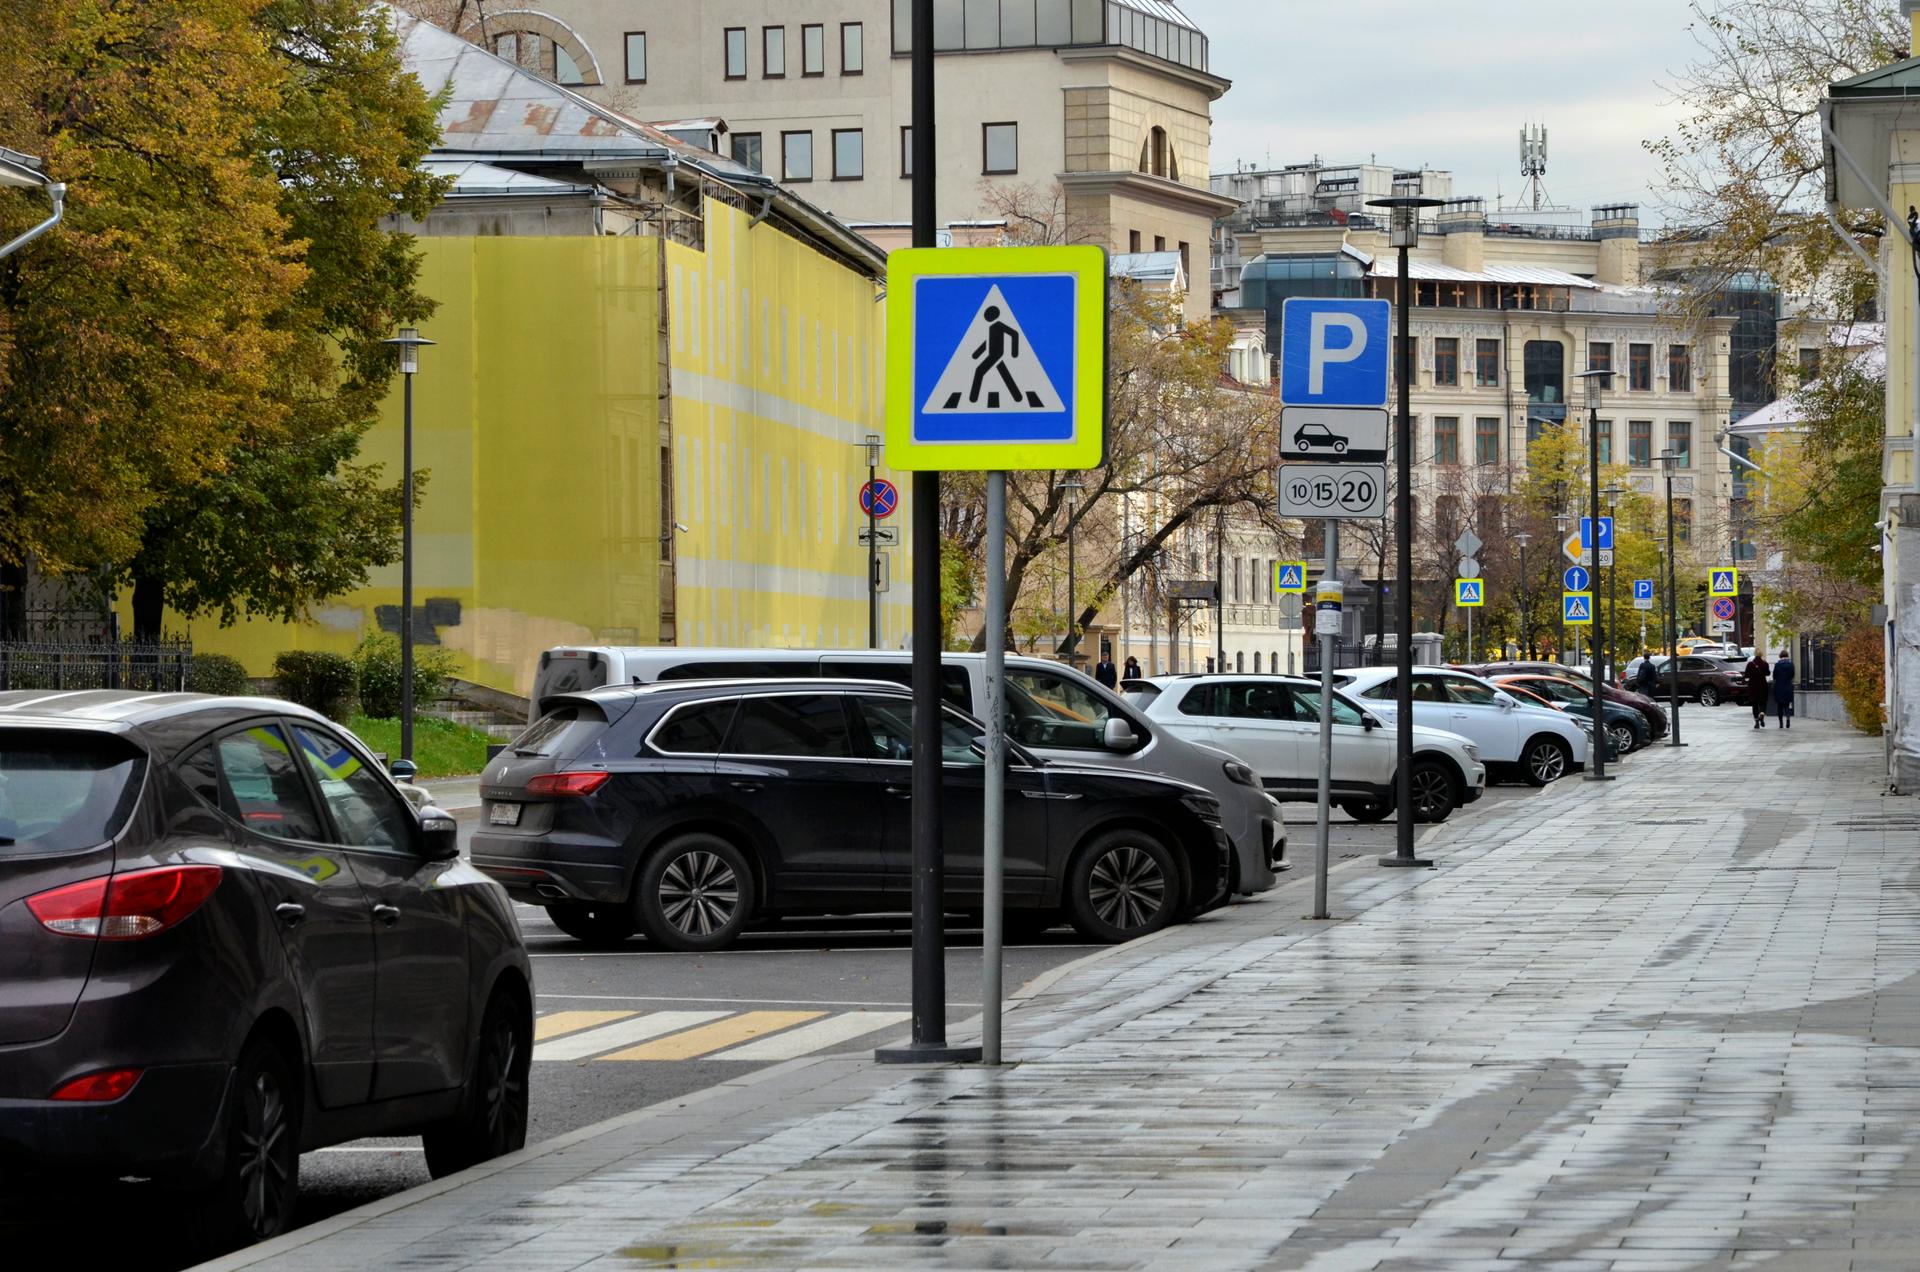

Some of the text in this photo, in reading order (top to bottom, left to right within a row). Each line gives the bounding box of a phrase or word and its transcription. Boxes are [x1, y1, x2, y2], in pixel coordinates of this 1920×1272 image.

[1308, 312, 1368, 395] P
[1291, 480, 1372, 503] 10 15 20
[1639, 583, 1649, 597] P
